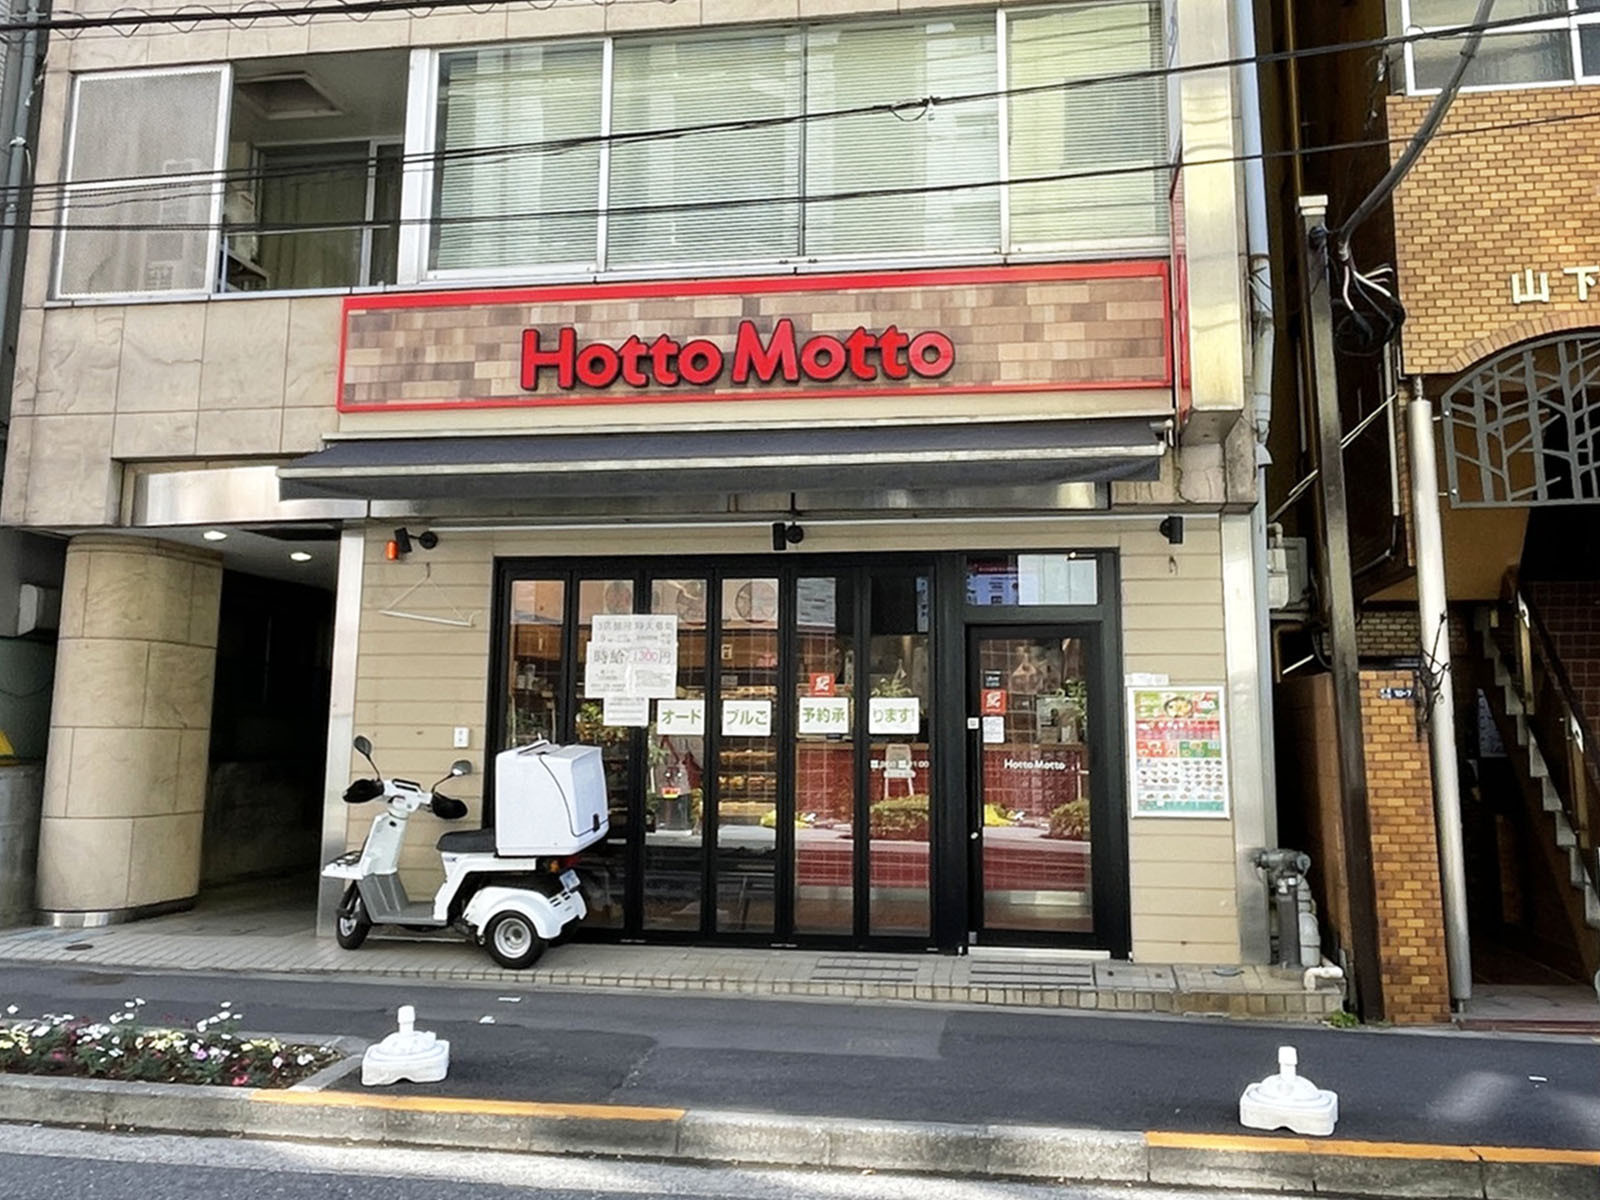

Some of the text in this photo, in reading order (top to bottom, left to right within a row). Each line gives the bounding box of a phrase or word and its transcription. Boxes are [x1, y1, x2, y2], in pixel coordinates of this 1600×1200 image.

[1512, 267, 1600, 303] 山下
[520, 318, 955, 391] Hotto Motto
[661, 708, 702, 725] オード
[726, 709, 768, 726] ブルご
[802, 707, 845, 724] 予約承
[1003, 758, 1066, 771] Hotto Motto
